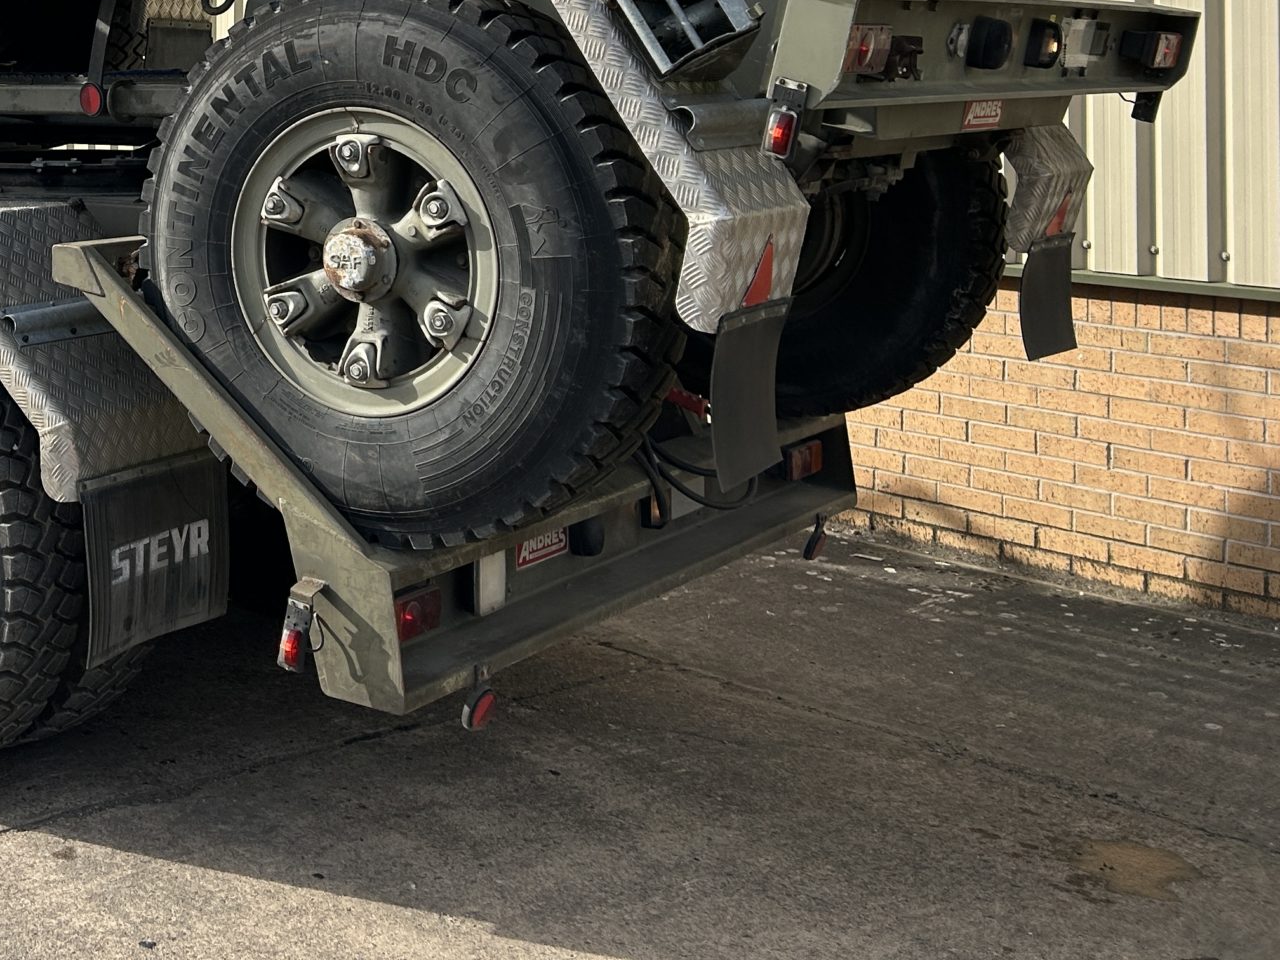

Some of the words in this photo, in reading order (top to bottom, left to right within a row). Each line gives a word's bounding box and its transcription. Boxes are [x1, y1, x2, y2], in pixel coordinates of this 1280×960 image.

[382, 34, 478, 104] HDC
[166, 39, 314, 344] CONTINENTAL
[459, 287, 536, 428] CONSTRUCTION
[111, 518, 210, 586] STEYR
[518, 528, 566, 564] ANDRES
